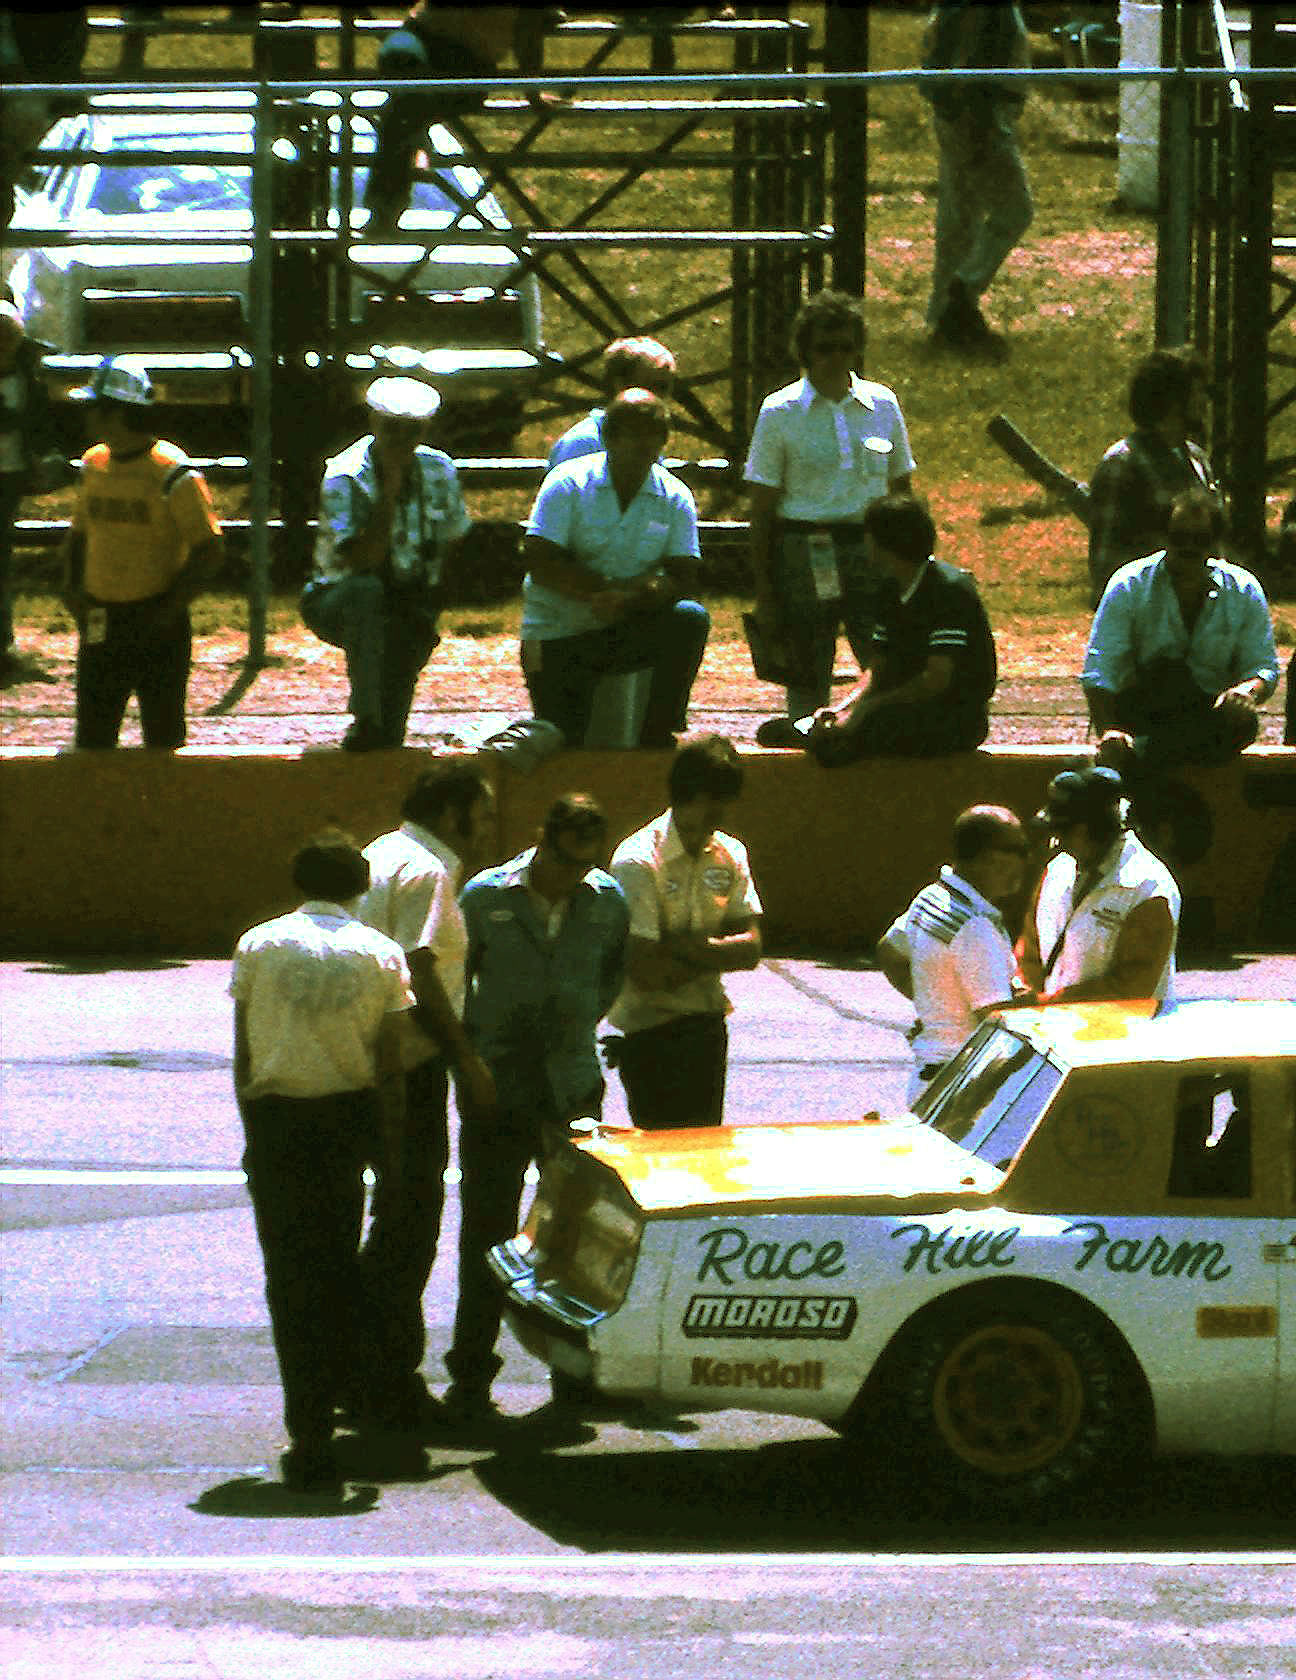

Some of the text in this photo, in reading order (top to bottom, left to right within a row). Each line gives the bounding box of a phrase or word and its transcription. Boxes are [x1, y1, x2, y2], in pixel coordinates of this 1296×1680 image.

[697, 1223, 1232, 1284] Race Hill Farm
[686, 1299, 850, 1329] MOROSO
[690, 1357, 824, 1390] Kendall
